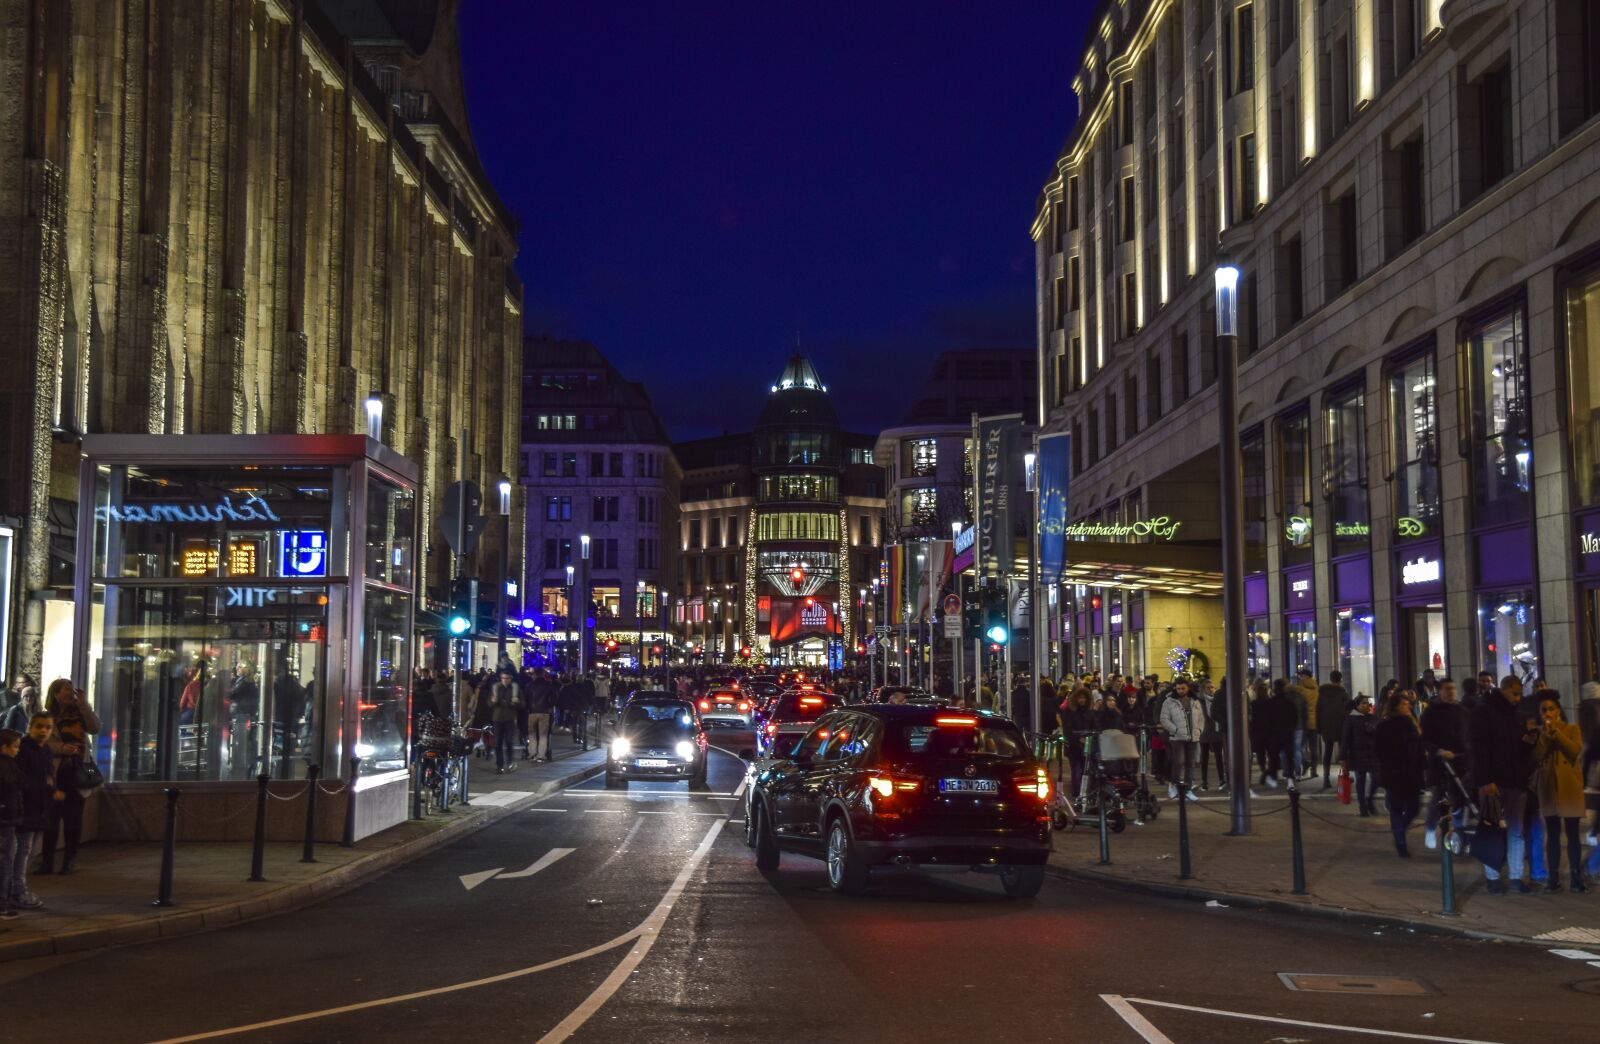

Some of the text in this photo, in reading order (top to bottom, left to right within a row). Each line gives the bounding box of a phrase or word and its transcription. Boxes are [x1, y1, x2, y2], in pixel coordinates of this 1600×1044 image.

[997, 485, 1009, 510] 1888
[1133, 516, 1181, 541] Hof
[1581, 533, 1600, 554] Ma
[975, 780, 997, 791] 2016
